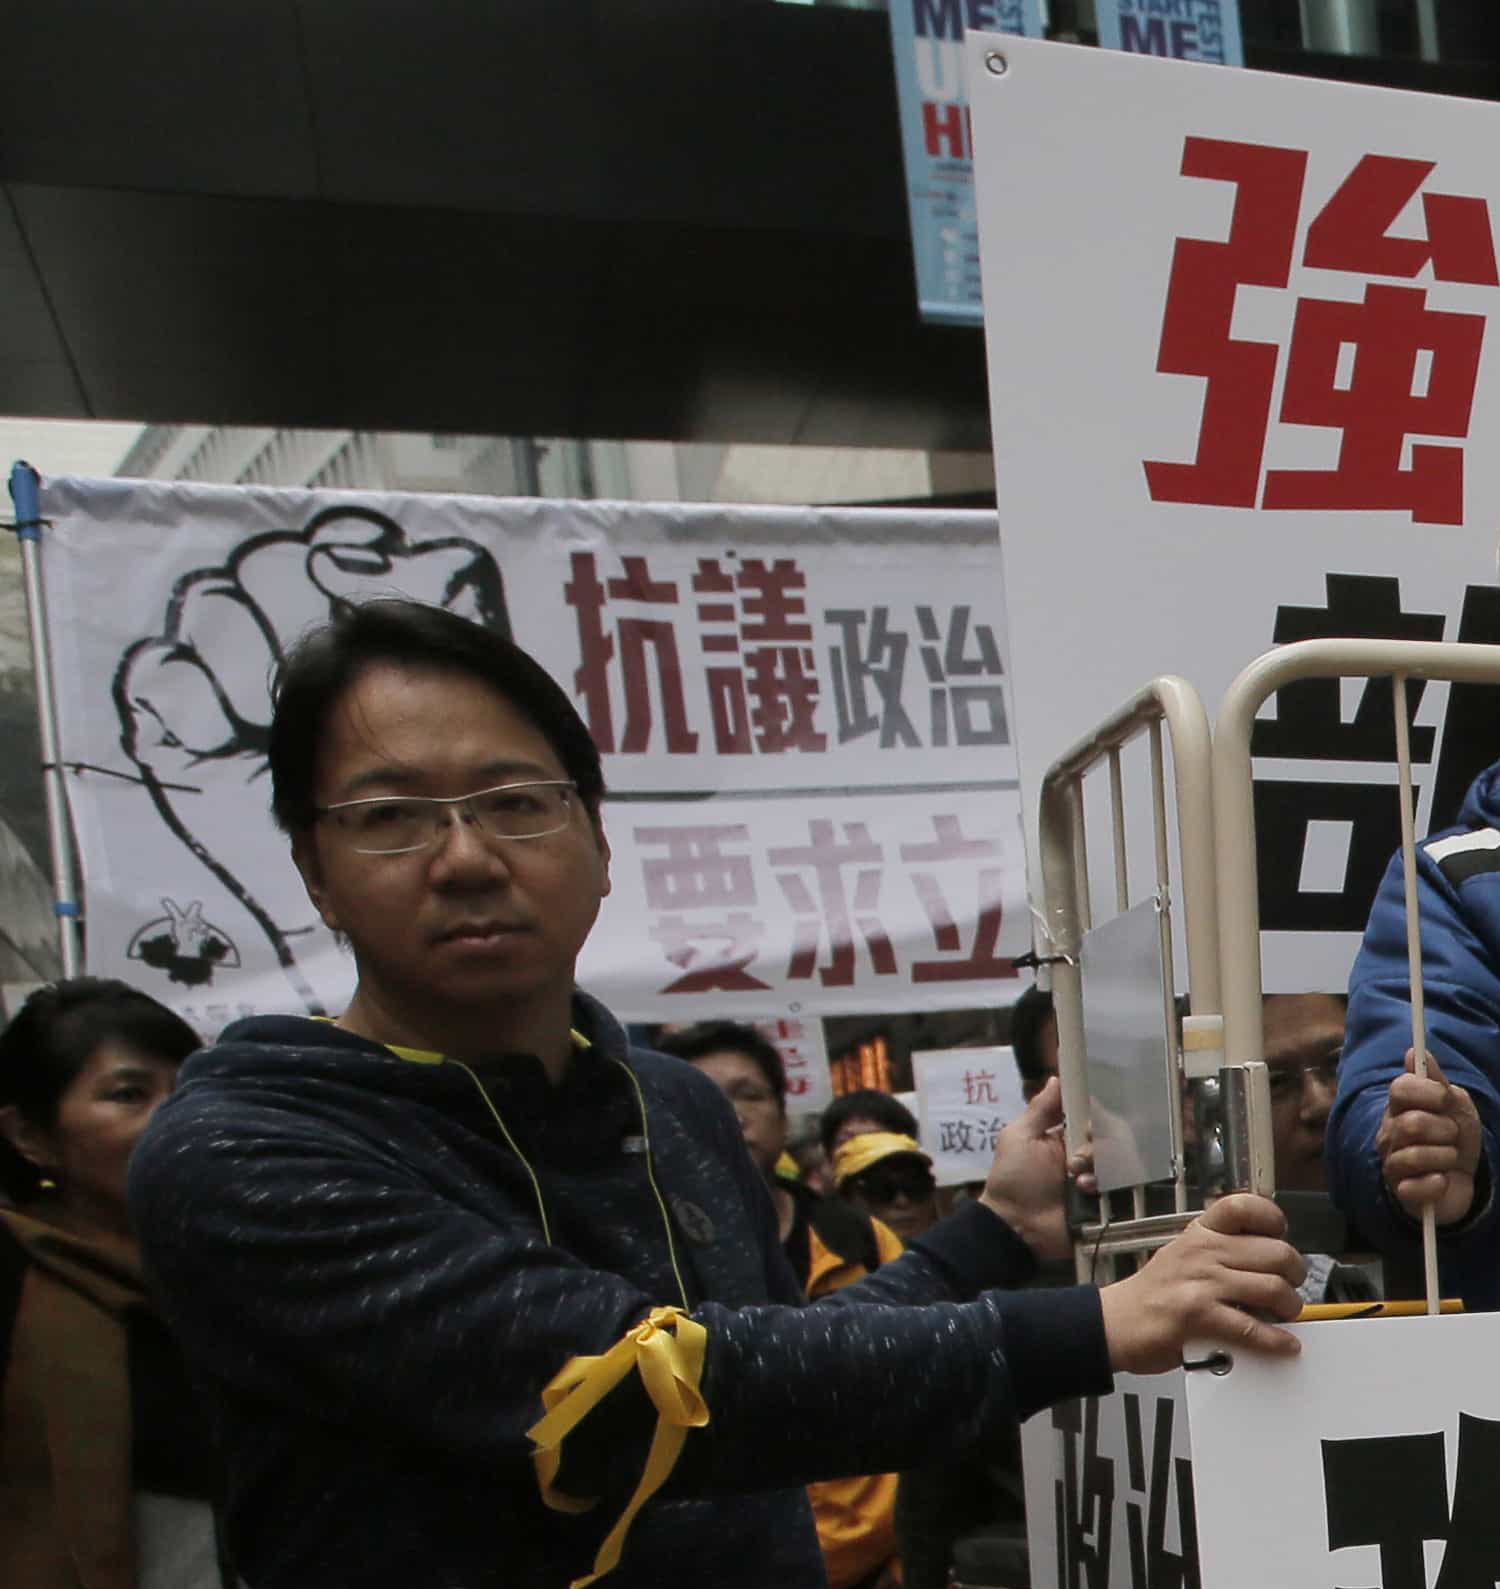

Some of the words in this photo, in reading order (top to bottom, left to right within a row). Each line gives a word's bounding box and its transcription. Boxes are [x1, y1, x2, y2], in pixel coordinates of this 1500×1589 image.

[921, 101, 970, 159] H
[632, 813, 1020, 994] 要求立
[961, 1069, 1000, 1105] 抗
